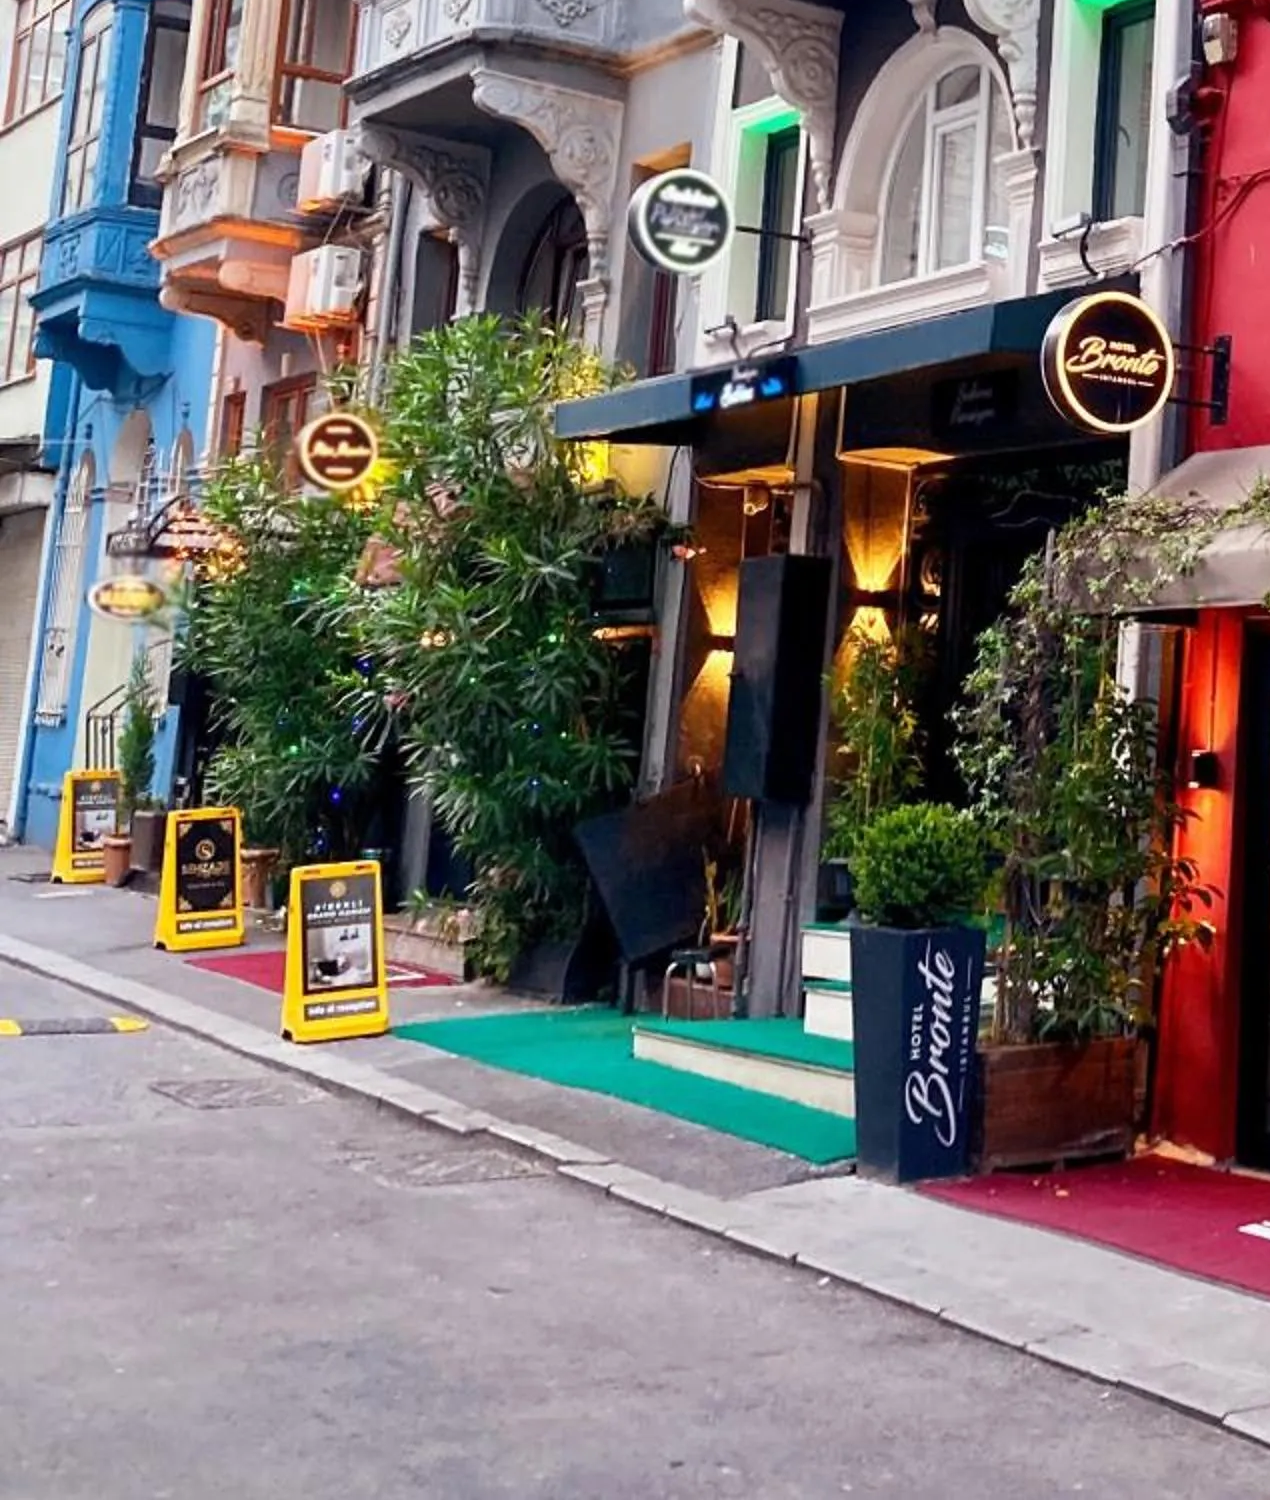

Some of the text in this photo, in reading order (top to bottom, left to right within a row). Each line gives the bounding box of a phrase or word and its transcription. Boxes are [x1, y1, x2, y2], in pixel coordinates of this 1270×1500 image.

[1065, 336, 1166, 376] Bronte
[905, 937, 956, 1147] Bronte
[910, 1003, 924, 1061] HOTEL
